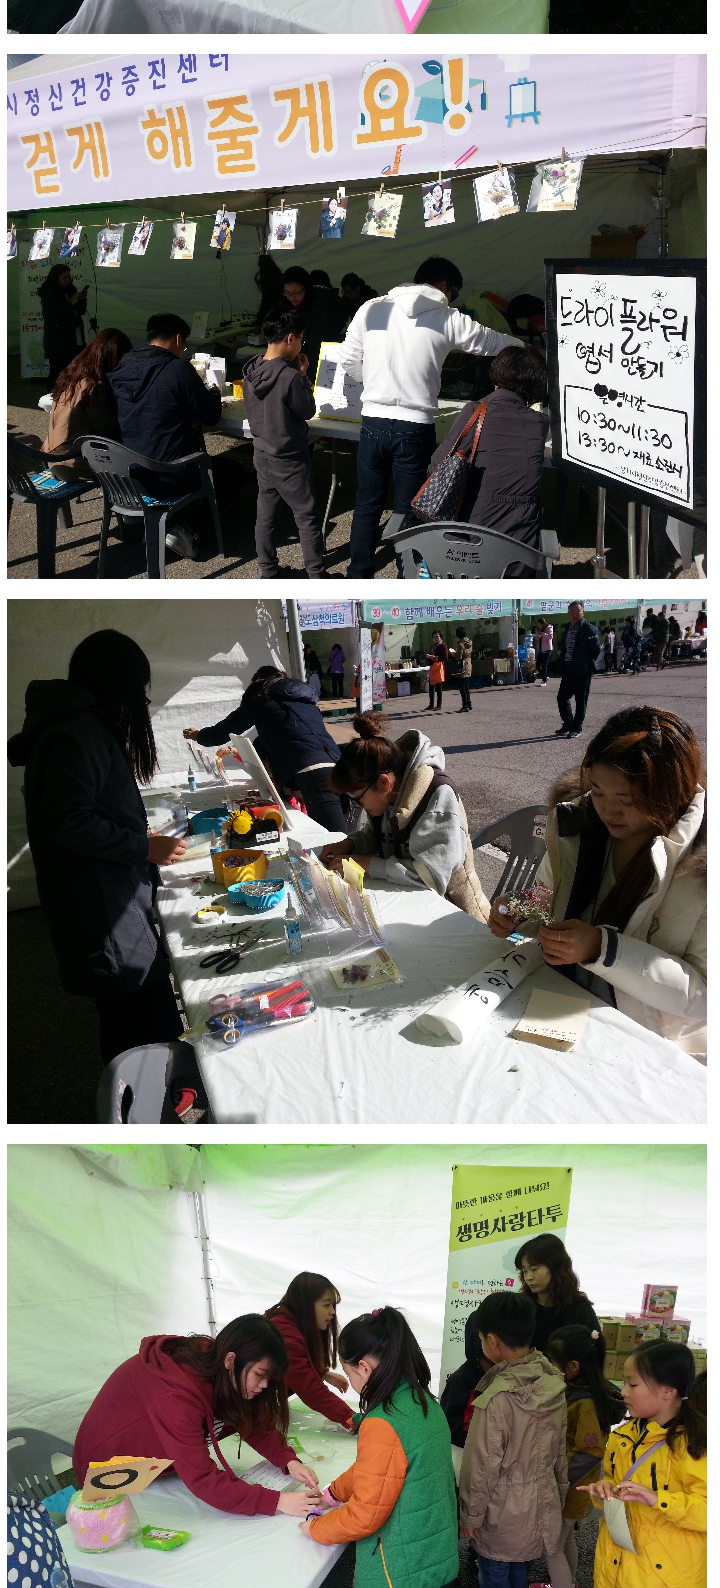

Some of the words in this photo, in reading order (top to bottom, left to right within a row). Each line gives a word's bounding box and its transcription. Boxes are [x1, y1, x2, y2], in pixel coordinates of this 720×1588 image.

[21, 121, 110, 195] 걷게
[141, 58, 469, 174] 해줄게요!
[22, 324, 44, 333] 1577-
[560, 296, 615, 327] 드라이
[620, 298, 688, 355] 플라워
[576, 342, 613, 374] 엽서
[621, 356, 664, 380] 만들기
[405, 607, 423, 621] 함께
[427, 606, 452, 619] 배우는
[456, 604, 472, 617] 우리
[486, 601, 502, 615] 빚기
[456, 1203, 563, 1243] 생명사랑타투
